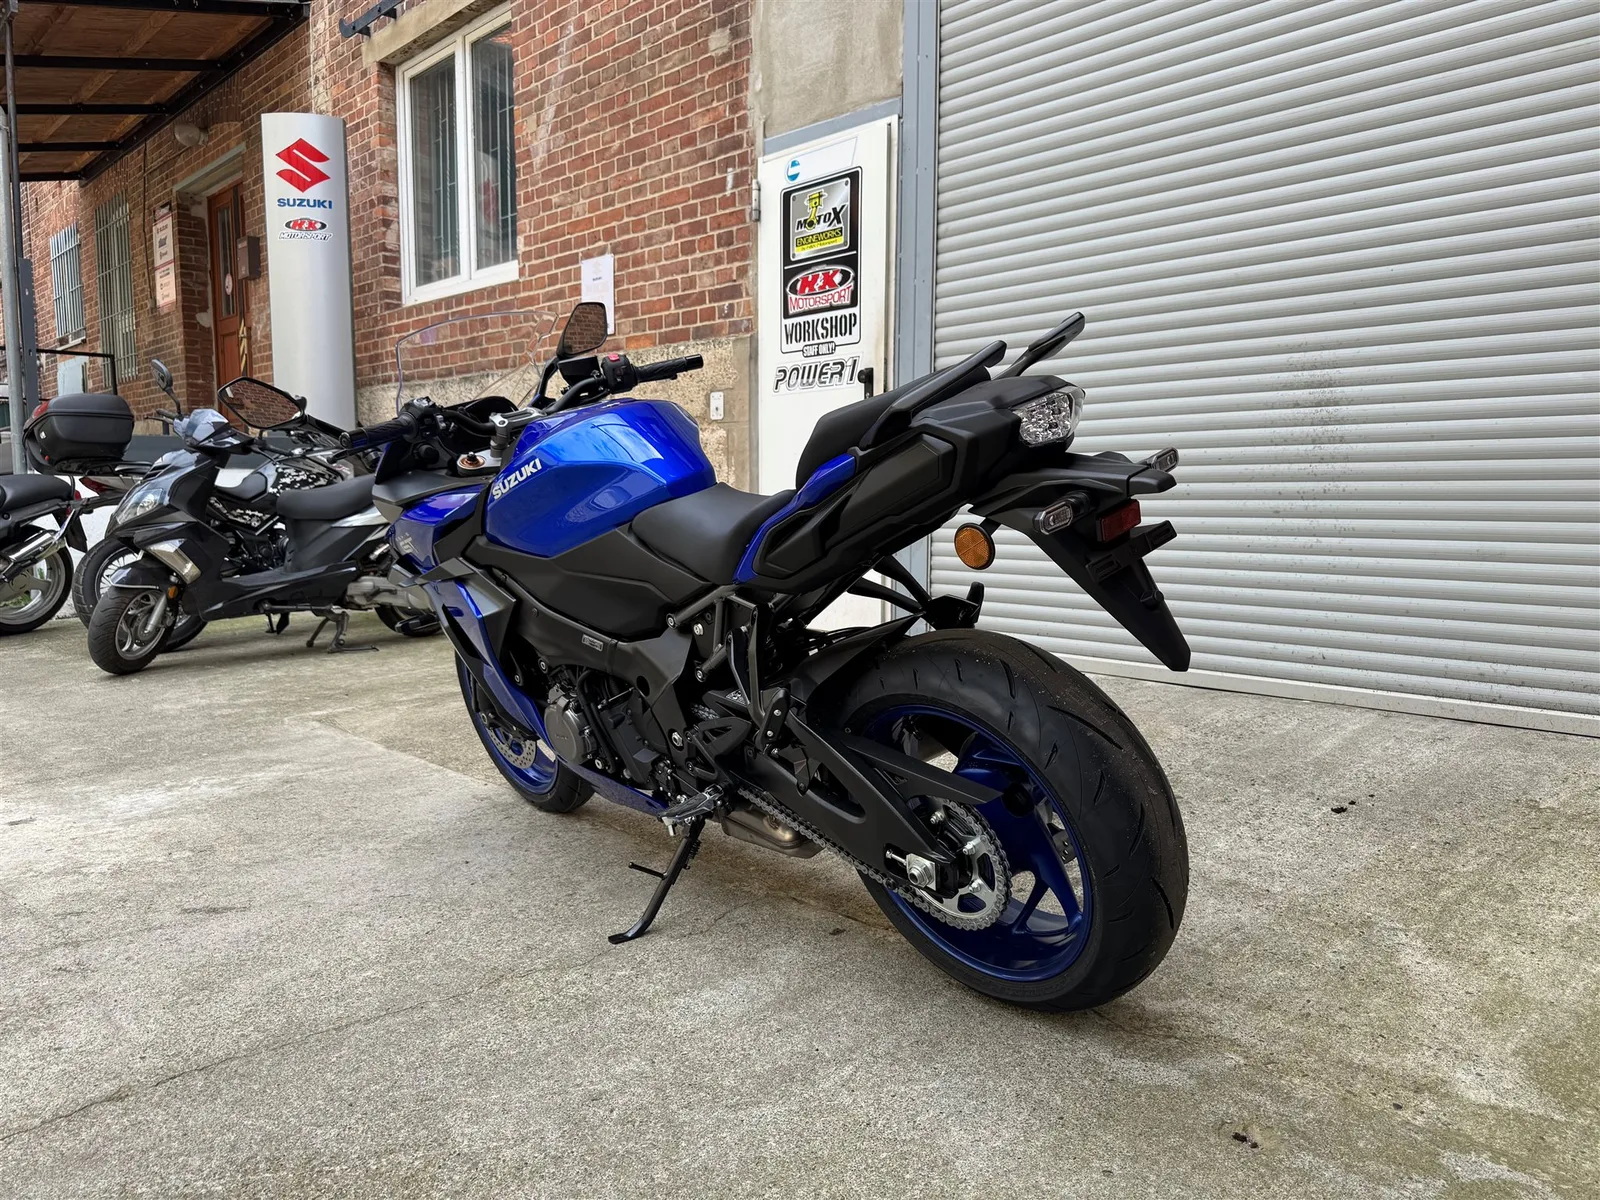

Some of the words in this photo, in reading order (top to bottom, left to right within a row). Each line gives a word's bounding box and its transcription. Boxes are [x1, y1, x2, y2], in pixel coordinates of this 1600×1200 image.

[277, 198, 333, 209] SUZUKI
[279, 231, 333, 241] MOTORSPORT
[796, 229, 842, 247] ENGINEWORKS
[788, 284, 853, 313] MOTORSPORT
[784, 312, 857, 345] WORKSHOP
[803, 344, 818, 357] STAFF
[818, 342, 835, 355] ONLY!
[774, 357, 860, 392] POWER1
[492, 458, 542, 499] SUZUKI
